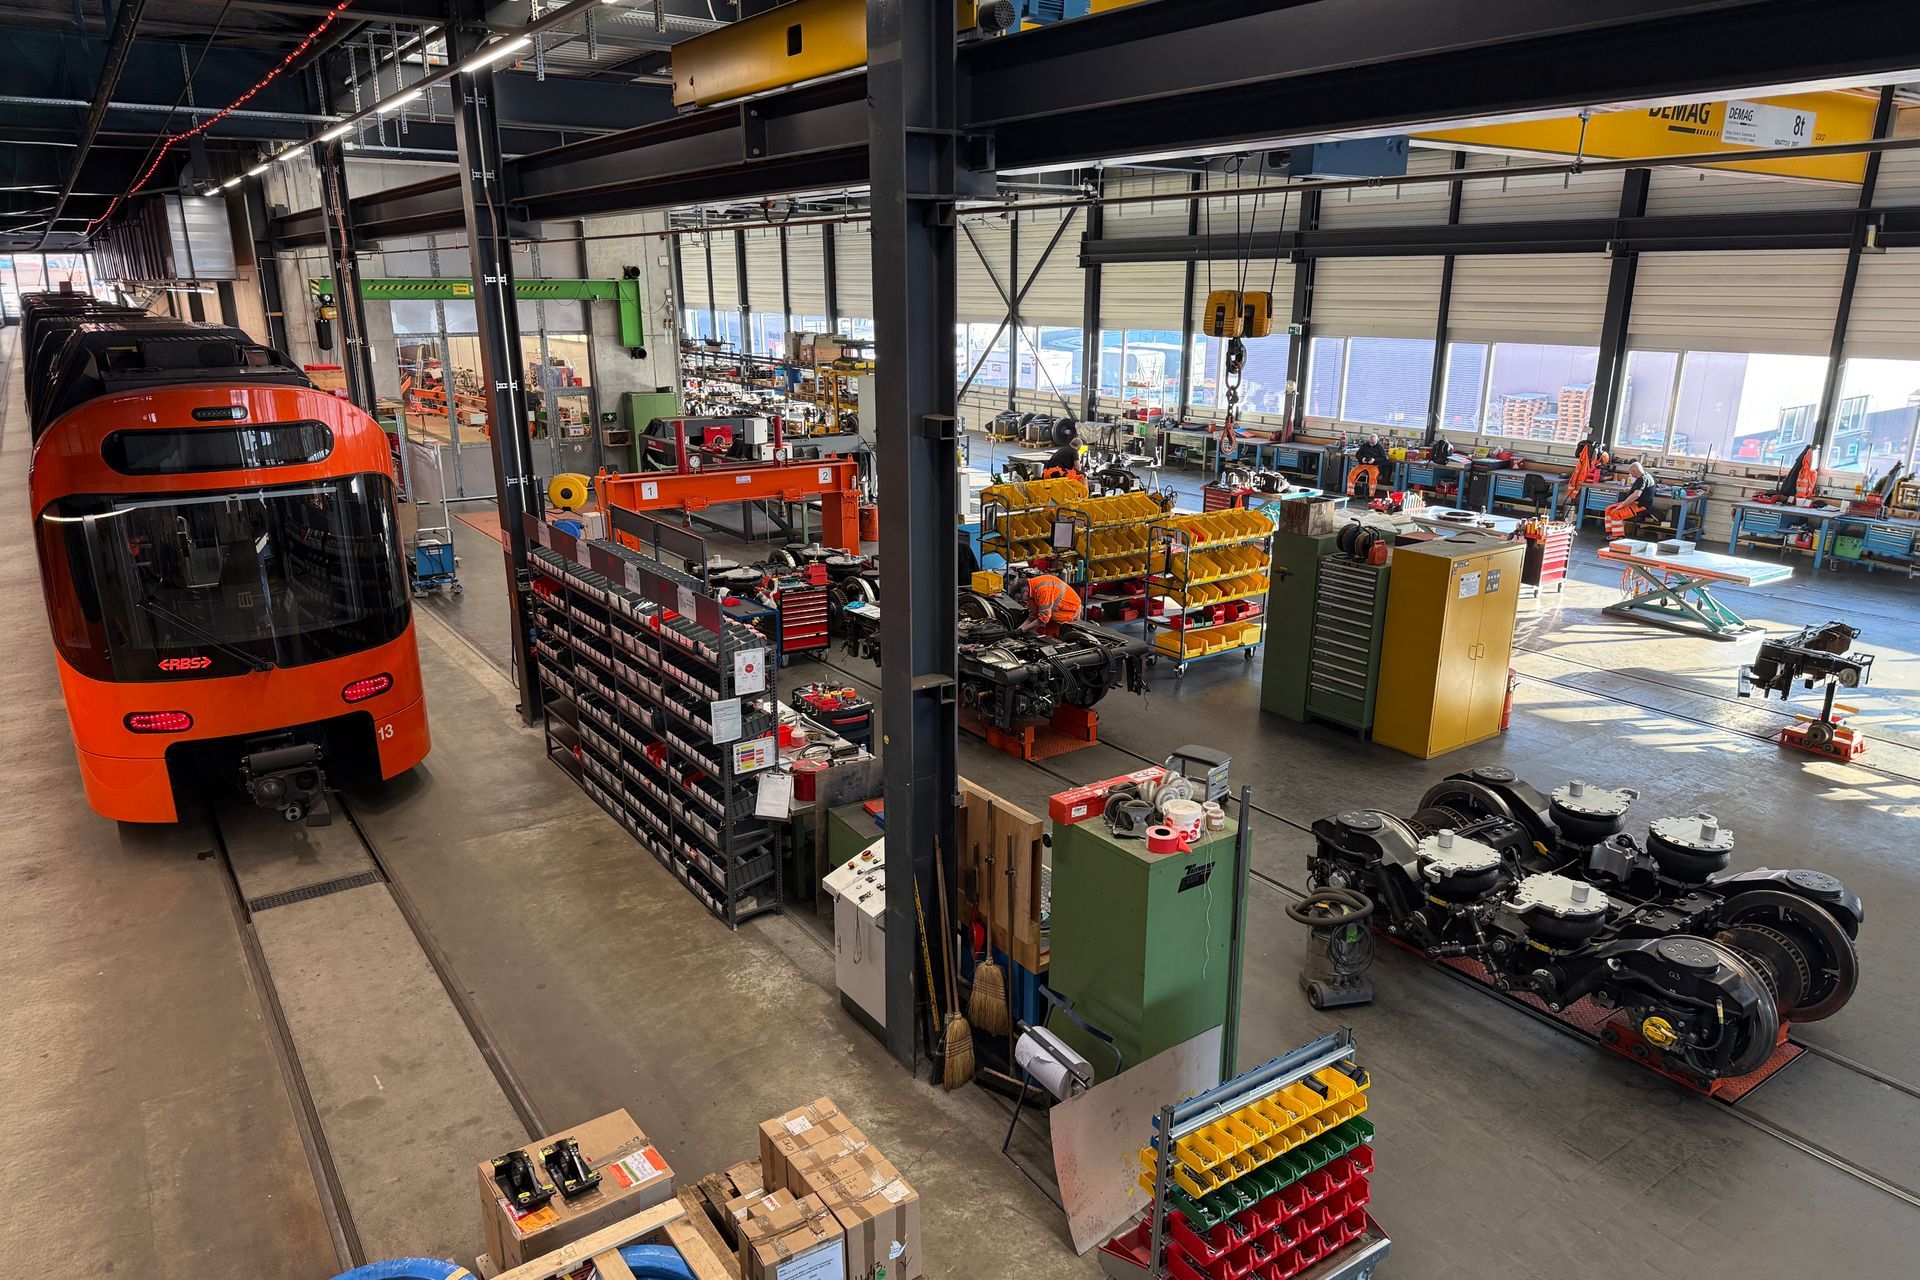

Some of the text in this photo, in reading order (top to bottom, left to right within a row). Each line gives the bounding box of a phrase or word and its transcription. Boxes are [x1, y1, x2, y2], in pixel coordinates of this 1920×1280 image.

[1729, 107, 1753, 121] DEMAG
[1793, 115, 1805, 136] 8t
[822, 471, 828, 481] 2
[647, 486, 652, 496] 1
[168, 657, 201, 671] RBS
[377, 723, 394, 740] 13
